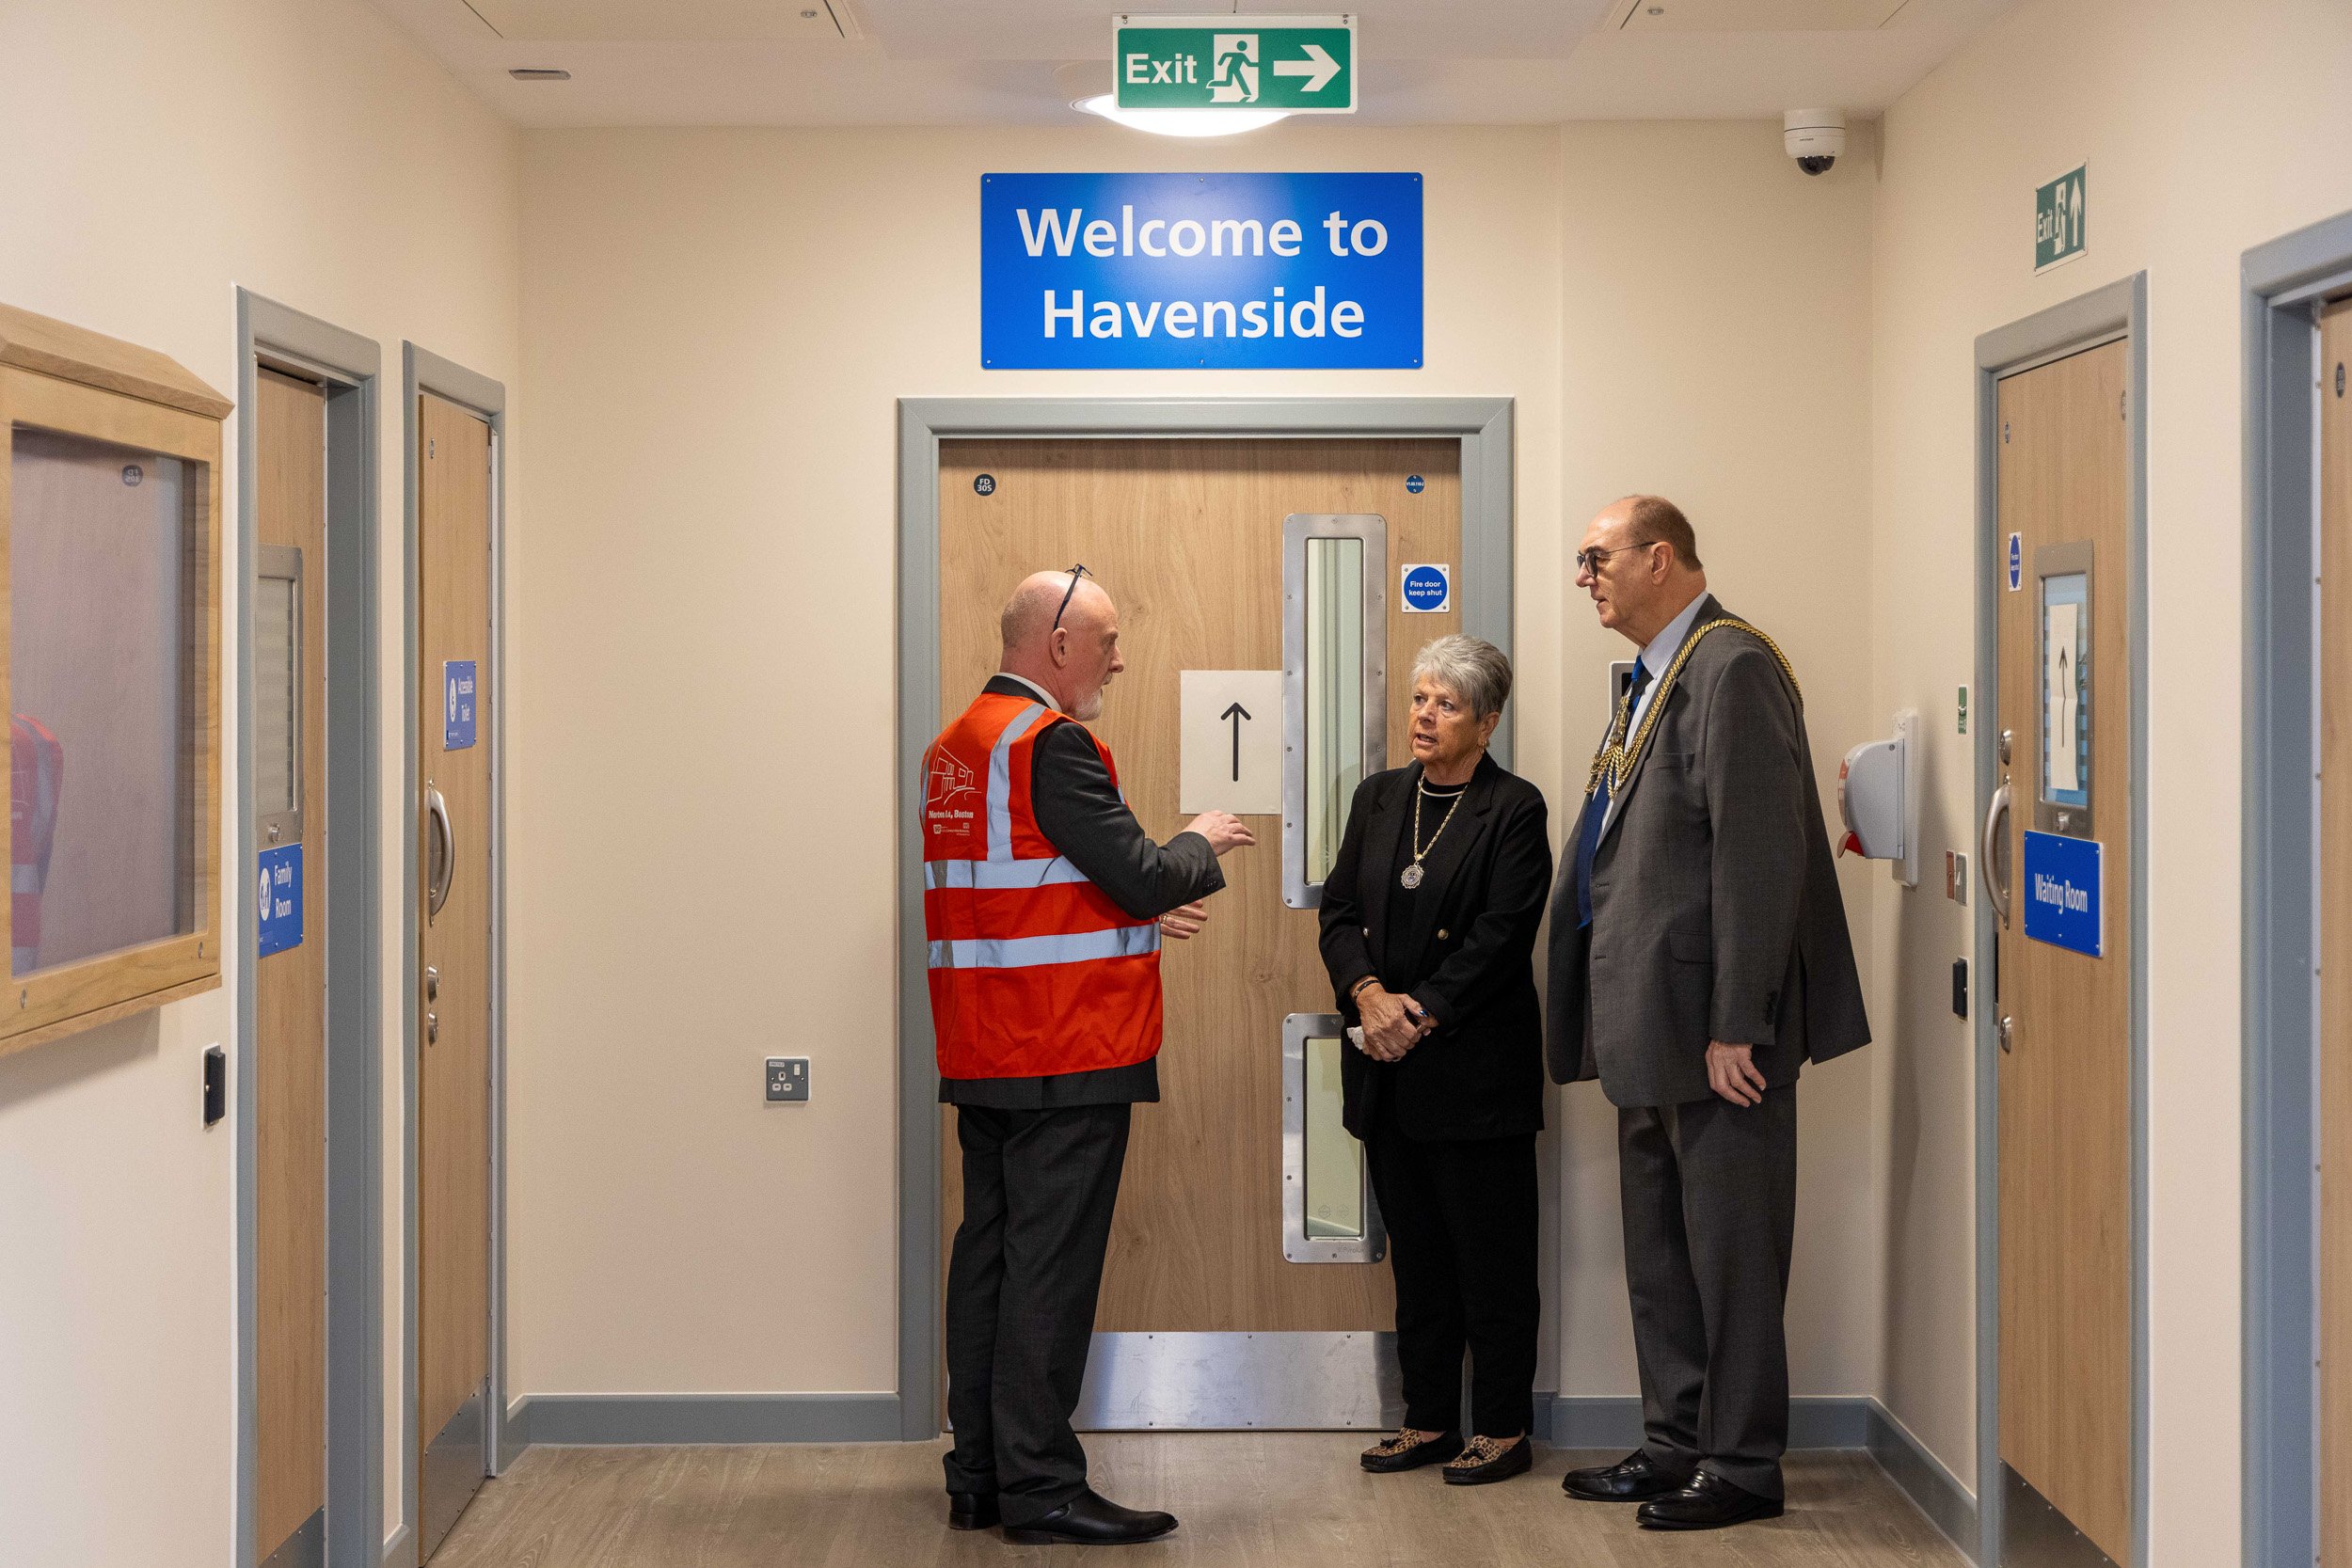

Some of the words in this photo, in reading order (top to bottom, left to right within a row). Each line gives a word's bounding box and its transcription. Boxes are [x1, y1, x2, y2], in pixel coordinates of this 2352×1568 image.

[1126, 53, 1198, 84] Exit
[1016, 205, 1303, 258] Welcome
[1323, 211, 1389, 258] to
[2037, 208, 2054, 244] Exit
[1043, 286, 1365, 339] Havenside
[954, 809, 974, 819] Boston
[274, 861, 293, 888] Family
[275, 897, 292, 919] Room
[2034, 873, 2064, 914] Waiting
[2065, 879, 2088, 913] Room
